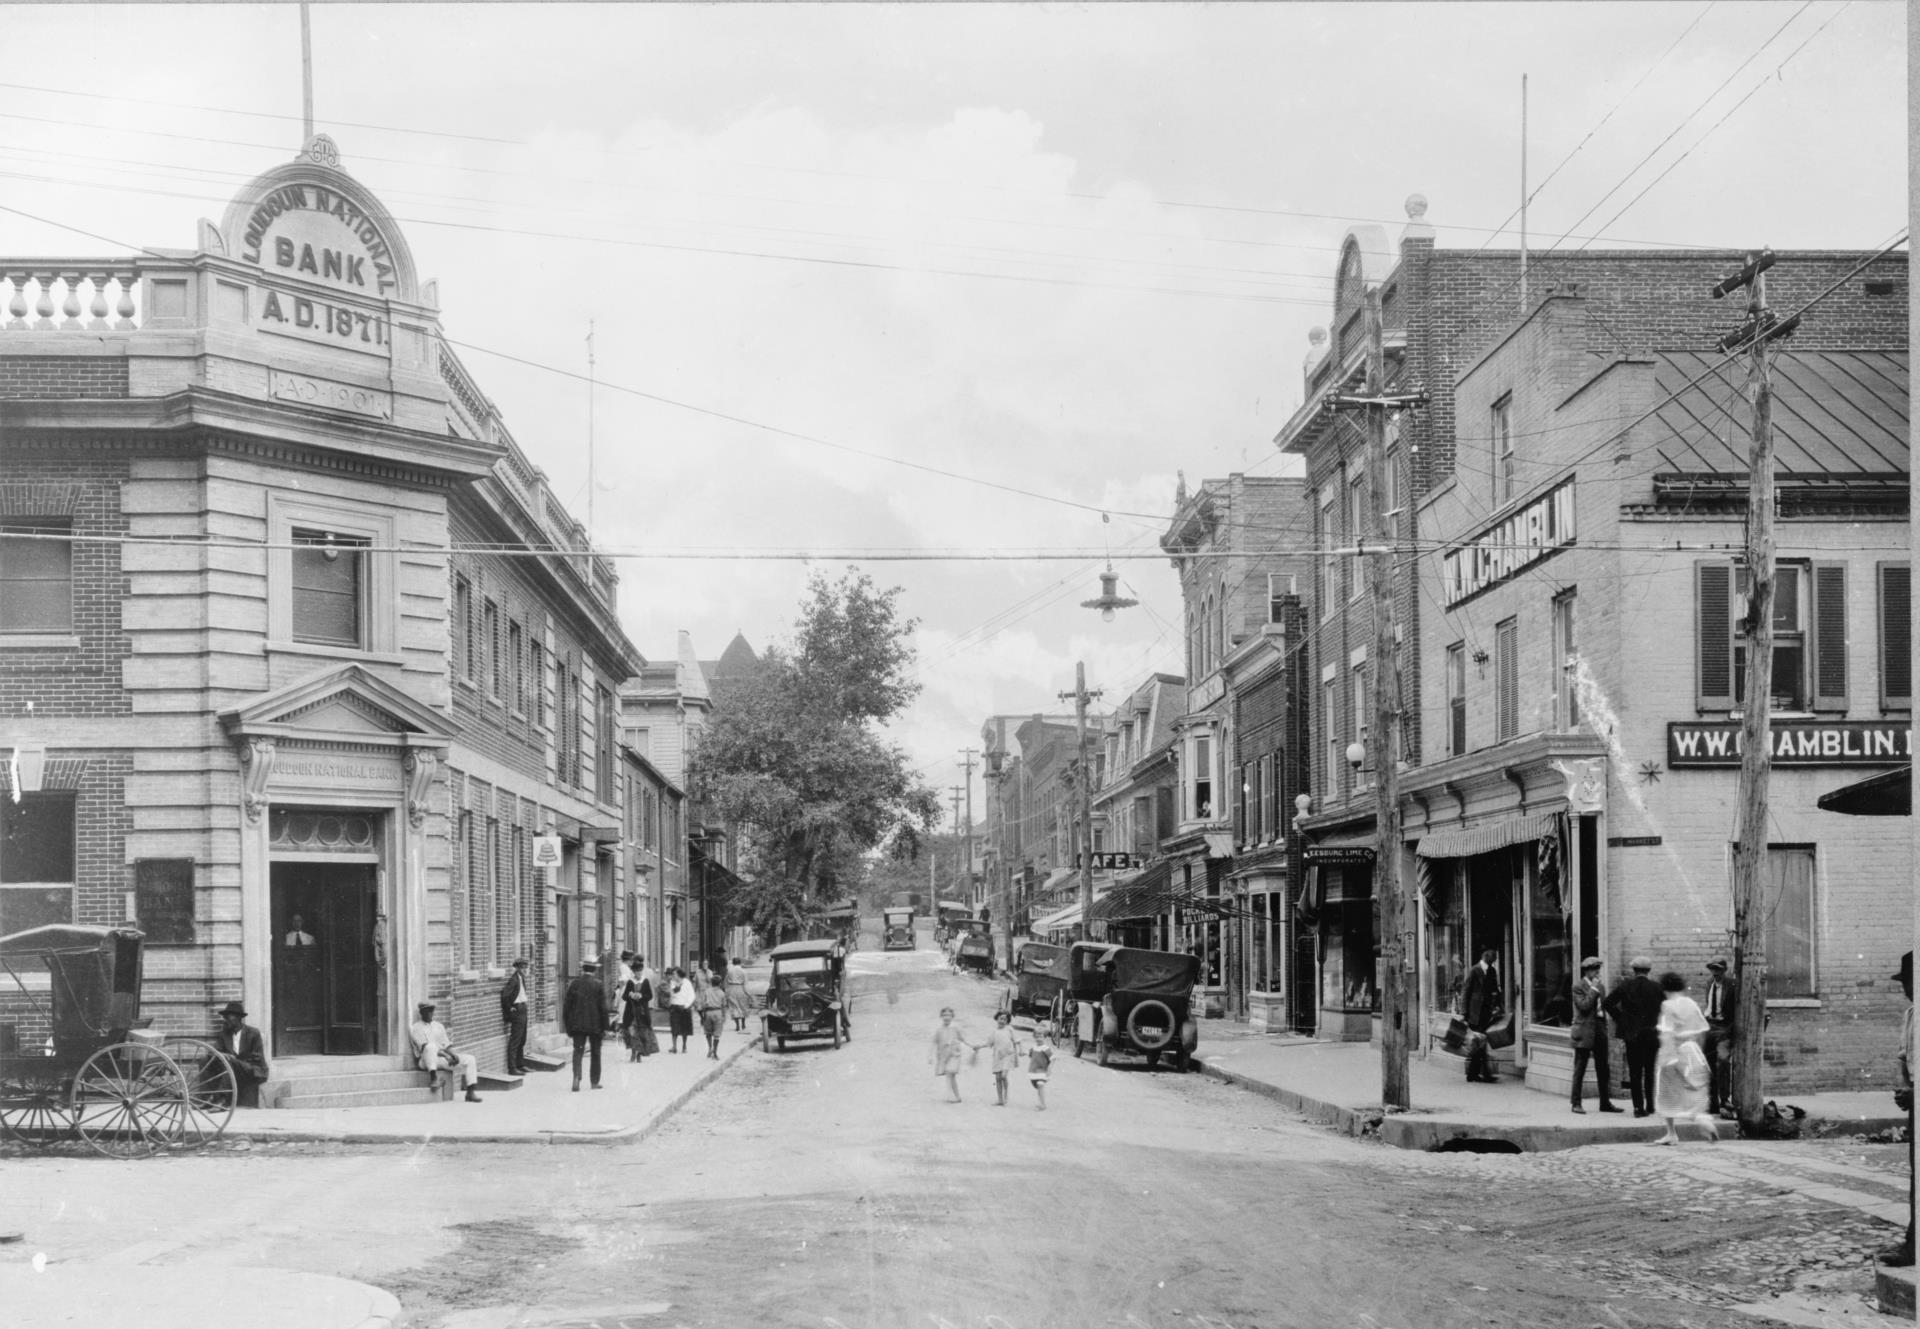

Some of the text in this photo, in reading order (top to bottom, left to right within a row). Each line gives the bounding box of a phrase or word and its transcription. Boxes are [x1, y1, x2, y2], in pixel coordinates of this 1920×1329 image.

[242, 184, 396, 295] LOUDOUN NATIONAL
[275, 236, 366, 287] BANK
[1735, 729, 1901, 756] AMBLIN.
[314, 763, 368, 779] NATIONAL
[1080, 854, 1126, 868] AFE
